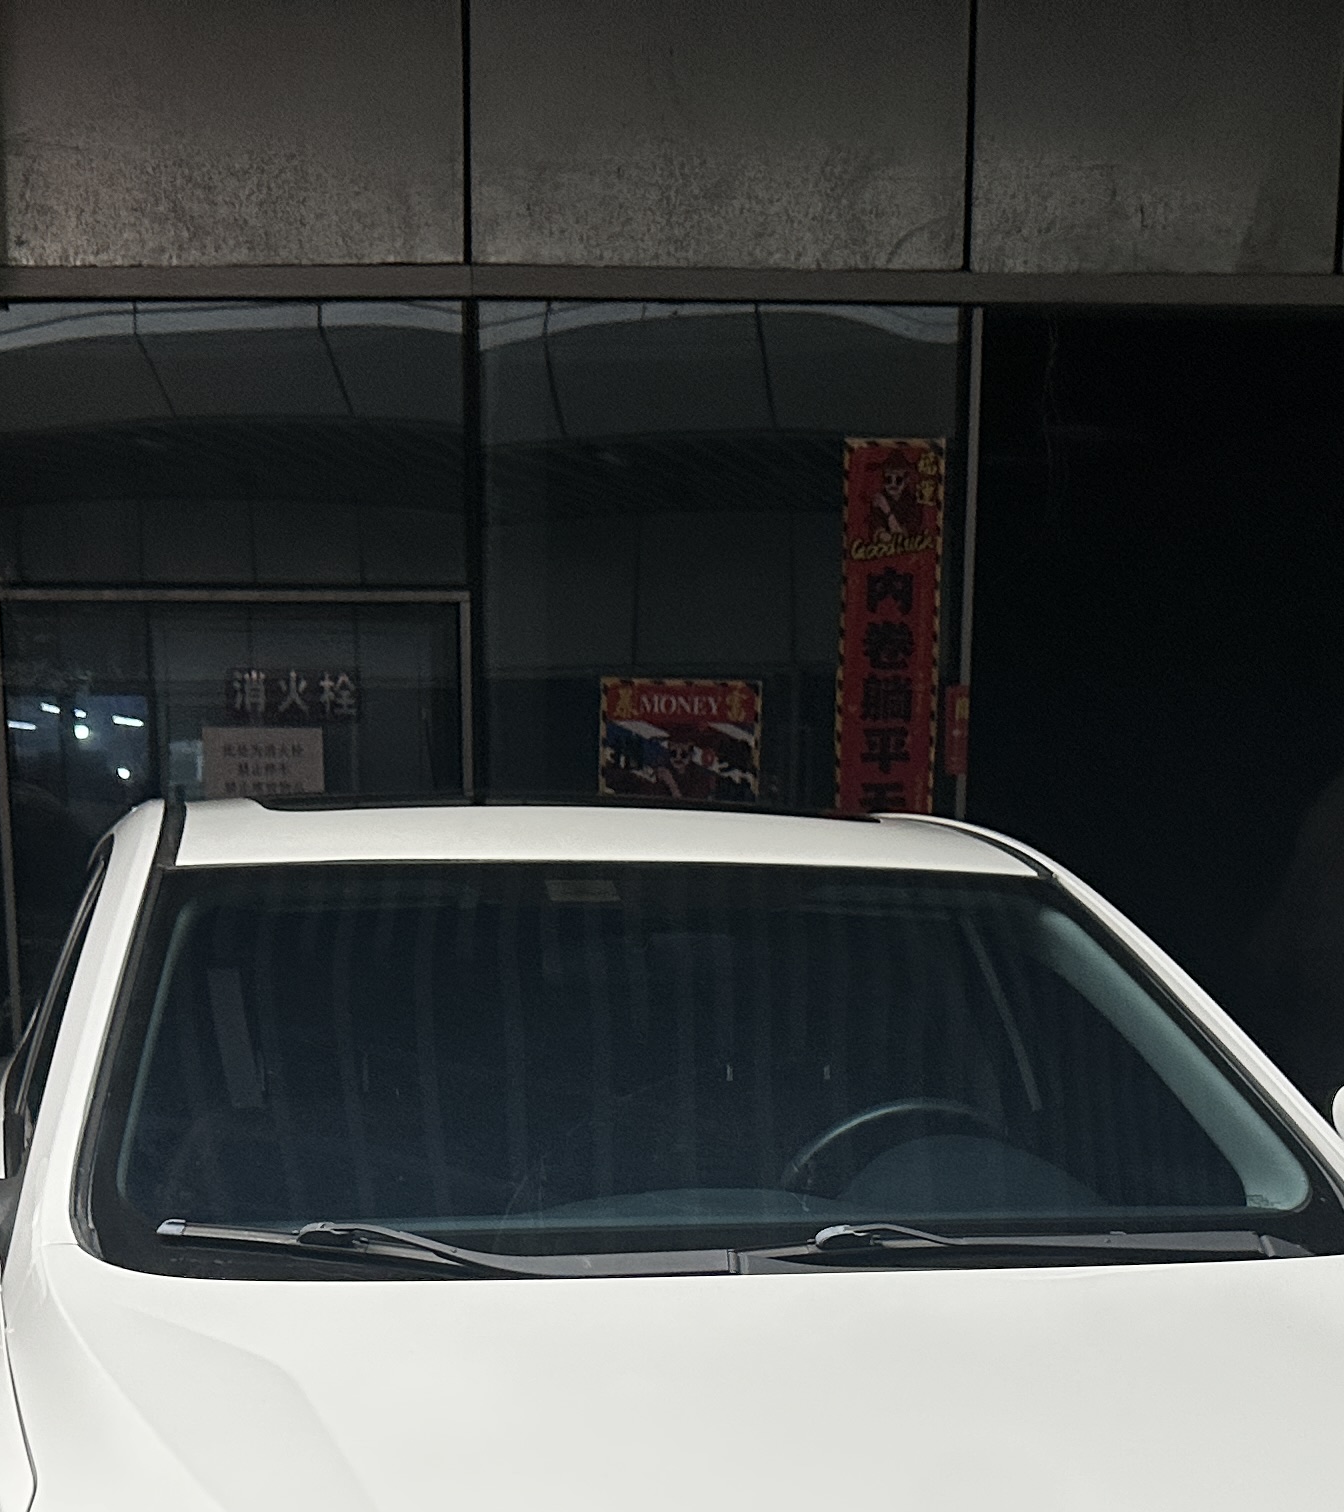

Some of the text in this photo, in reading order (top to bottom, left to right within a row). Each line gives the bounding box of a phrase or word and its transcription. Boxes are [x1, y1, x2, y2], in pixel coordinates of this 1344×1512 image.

[232, 669, 357, 717] 消火栓
[639, 694, 721, 715] MONEY
